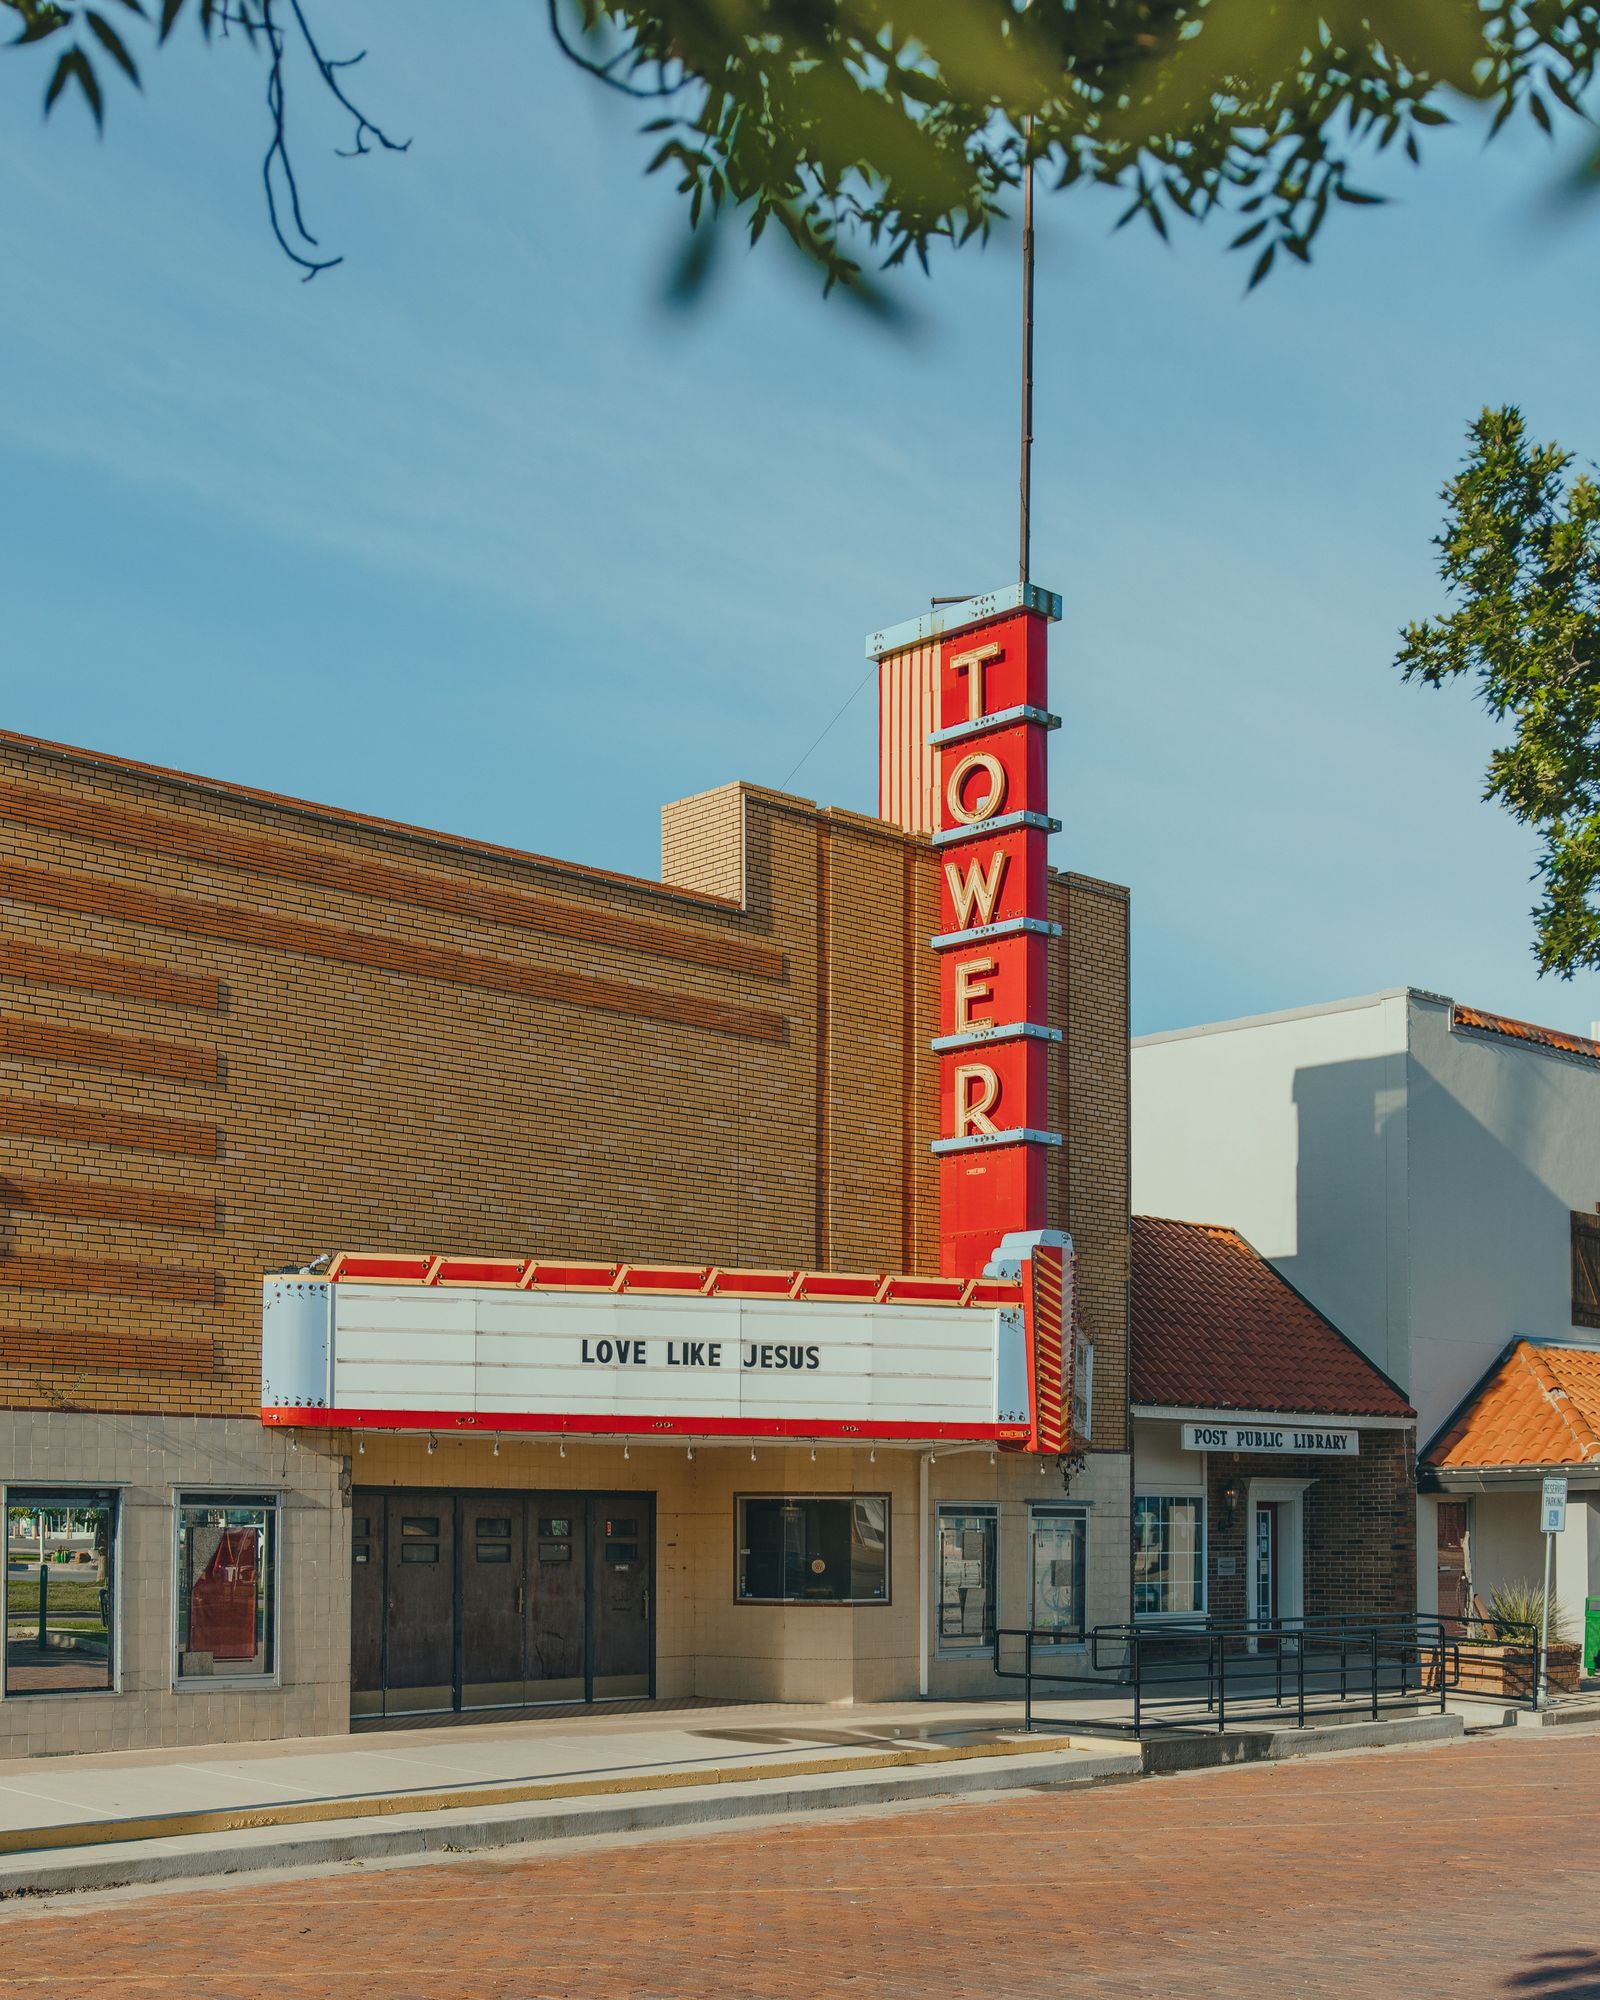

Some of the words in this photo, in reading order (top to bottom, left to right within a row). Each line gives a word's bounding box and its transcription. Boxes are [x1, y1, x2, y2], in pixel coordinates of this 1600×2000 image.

[944, 641, 1007, 1138] TOWER
[581, 1339, 647, 1364] LOVE
[667, 1341, 722, 1367] LIKE
[743, 1344, 820, 1369] JESUS
[1194, 1428, 1228, 1446] POST
[1237, 1431, 1283, 1448] PUBLIC
[1294, 1433, 1348, 1450] LIBRARY
[1544, 1483, 1566, 1495] RESERVED
[1545, 1496, 1563, 1507] PARKING
